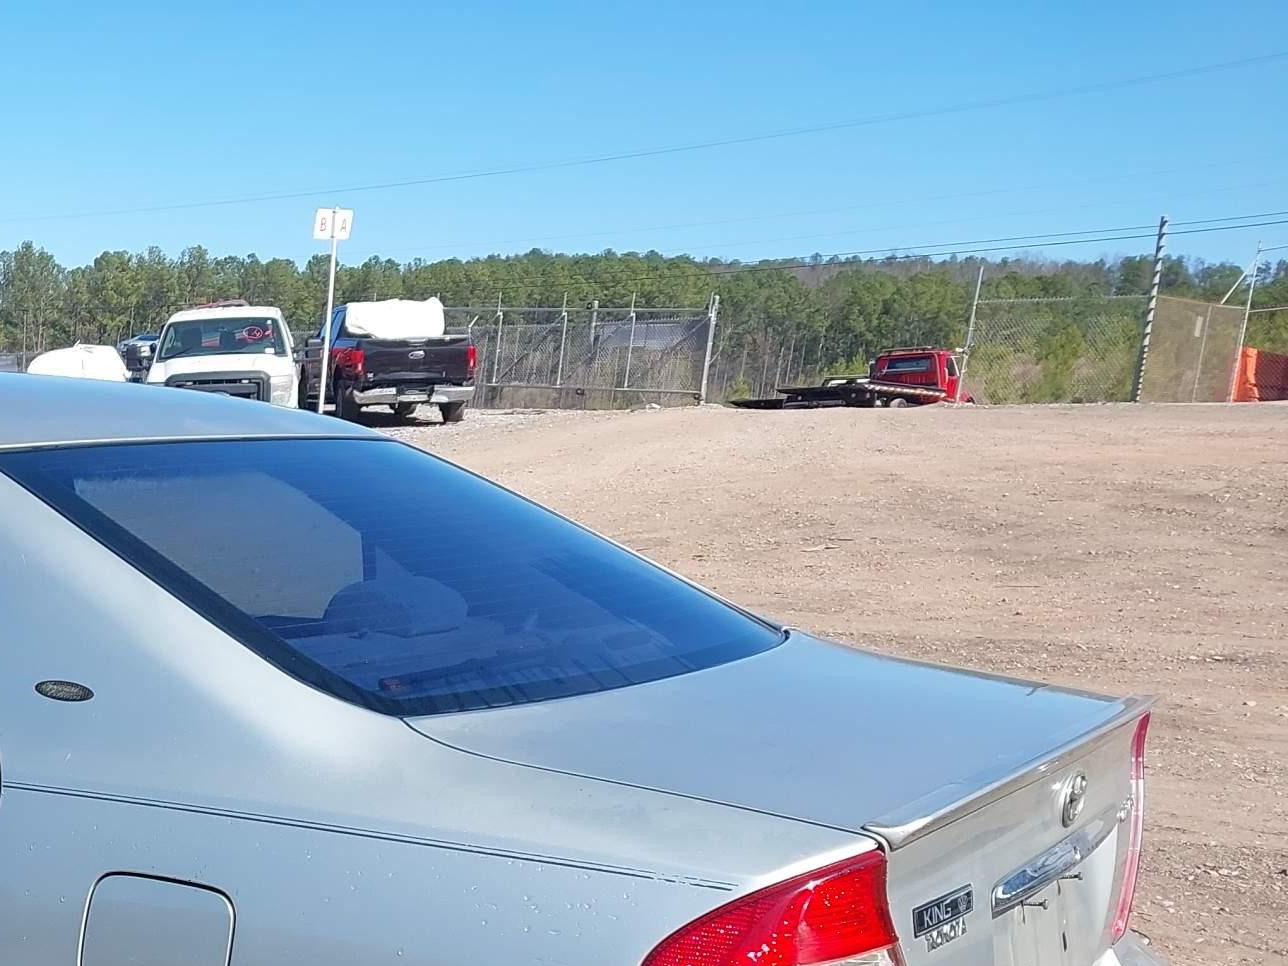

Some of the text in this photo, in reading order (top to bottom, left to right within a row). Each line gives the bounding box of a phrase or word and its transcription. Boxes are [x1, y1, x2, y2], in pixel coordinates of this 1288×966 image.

[320, 217, 327, 231] B
[340, 218, 347, 232] A
[922, 902, 952, 929] KING
